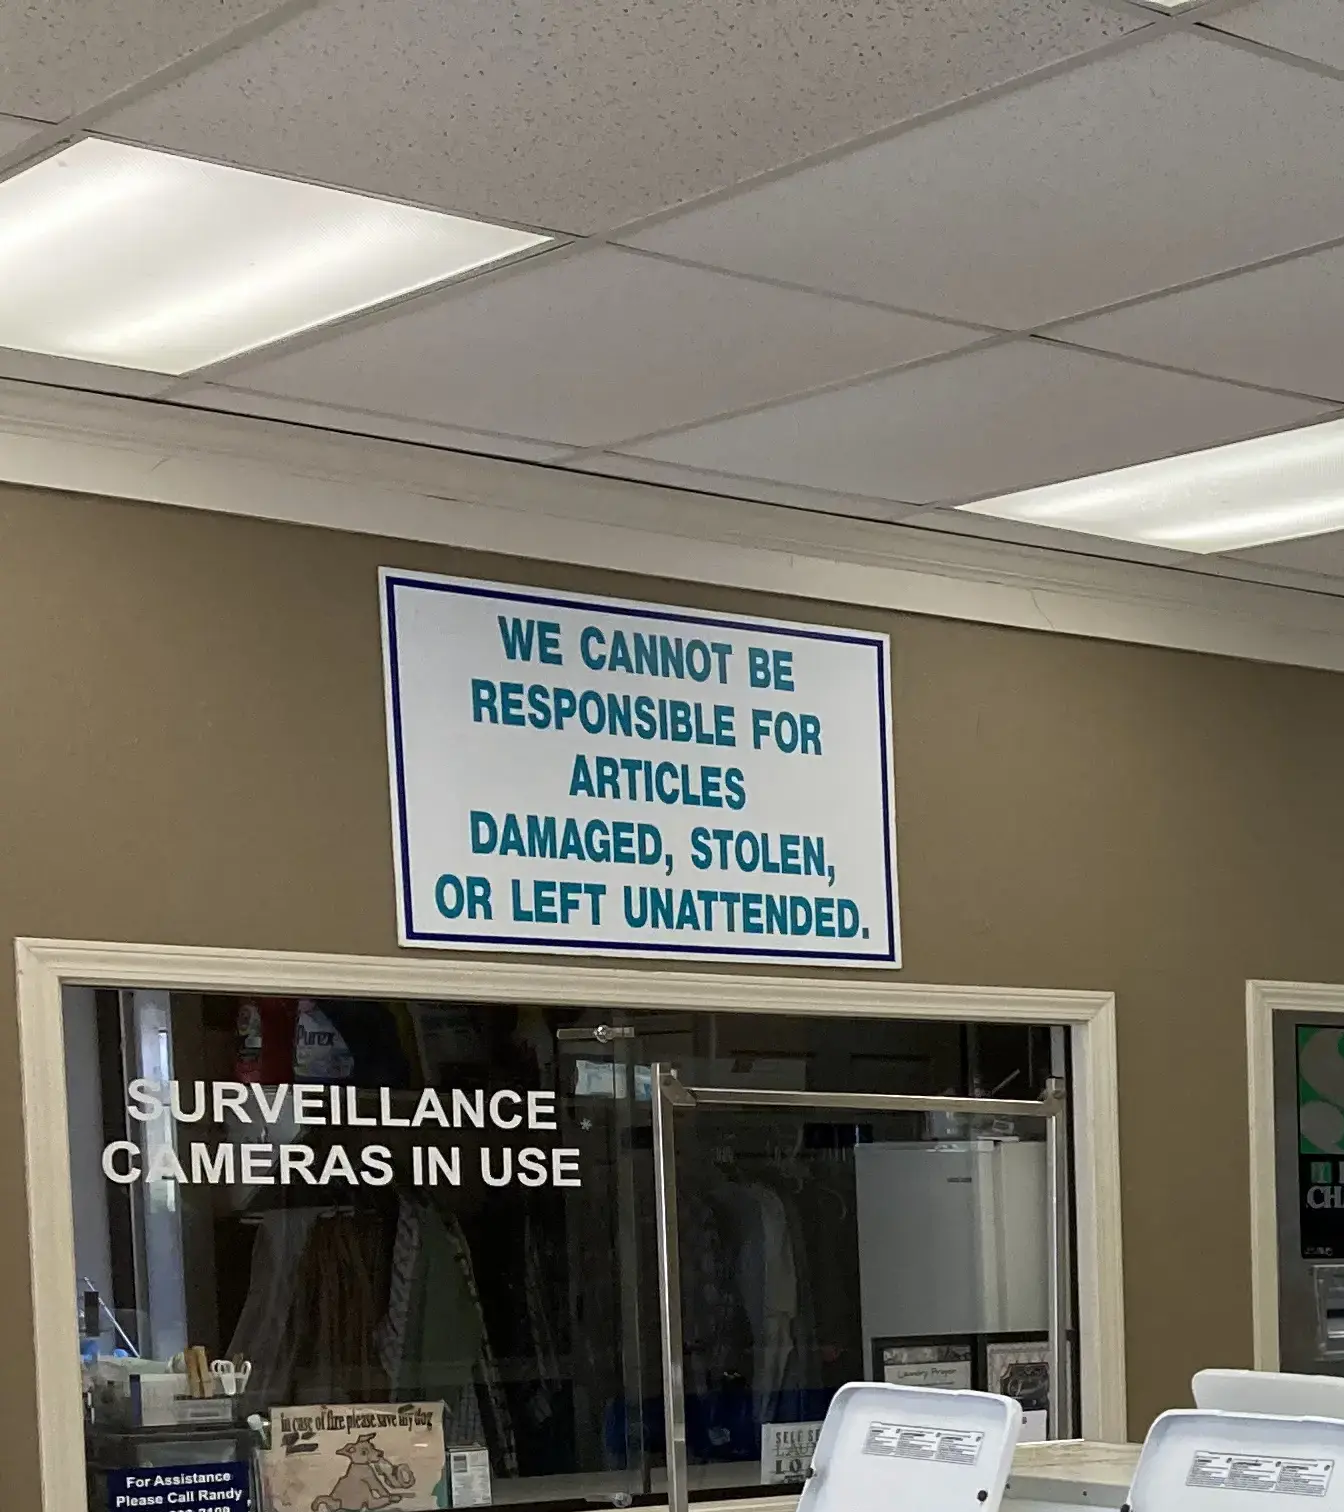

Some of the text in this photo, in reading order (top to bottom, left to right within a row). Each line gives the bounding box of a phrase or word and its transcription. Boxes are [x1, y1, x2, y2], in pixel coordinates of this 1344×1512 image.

[499, 616, 795, 692] WE CANNOT BE
[471, 678, 822, 756] RESPONSIBLE FOR
[569, 754, 747, 811] ARTICLES
[470, 810, 836, 888] DAMAGED, STOLEN,
[435, 874, 870, 940] OR LEFT UNATTENDED.
[126, 1078, 559, 1132] SURVEILLANCE
[102, 1140, 582, 1188] CAMERAS IN USE
[281, 1412, 291, 1432] in
[315, 1411, 326, 1430] of
[326, 1409, 346, 1430] fire
[346, 1411, 376, 1434] please
[116, 1487, 243, 1508] Please Call Randy
[126, 1472, 231, 1489] For Assistance
